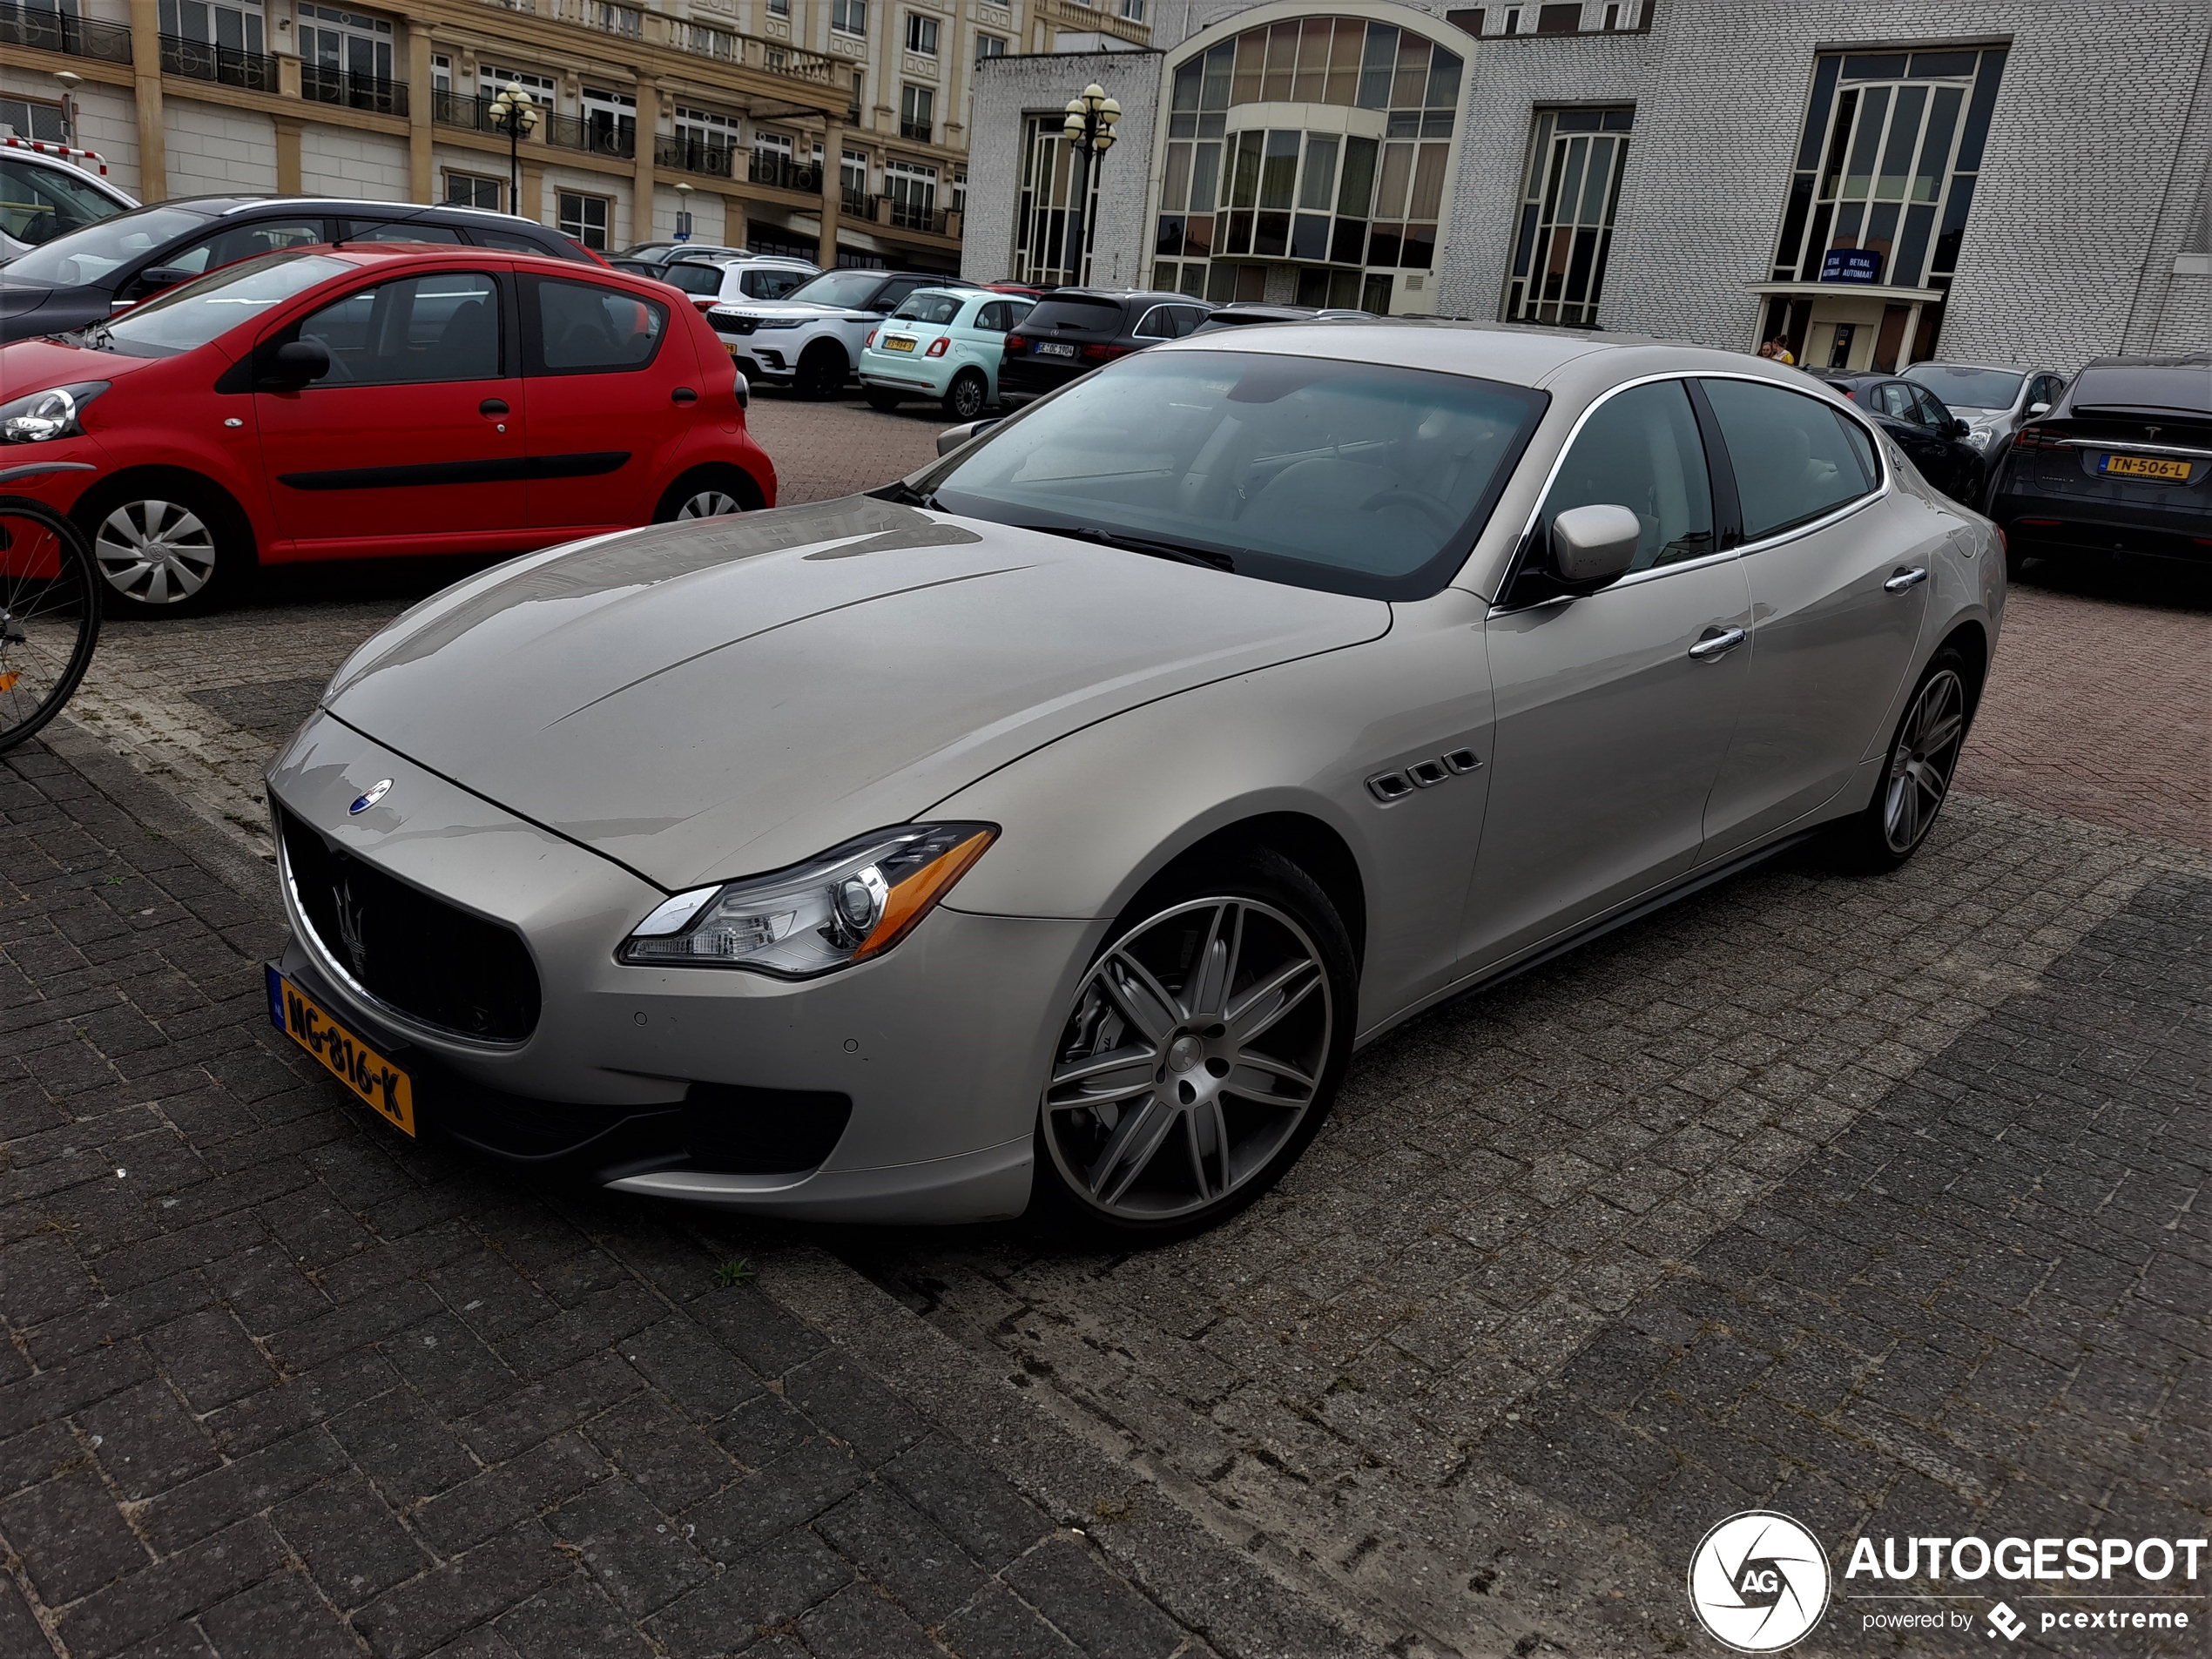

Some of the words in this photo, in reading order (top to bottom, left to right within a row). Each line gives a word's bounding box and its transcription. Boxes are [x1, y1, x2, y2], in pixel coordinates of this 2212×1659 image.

[1849, 258, 1871, 267] BETAAL
[1842, 268, 1873, 279] AUTOMAAT
[2113, 457, 2183, 476] TN-506-L
[274, 1002, 285, 1019] NL
[287, 990, 404, 1121] NG-816-K
